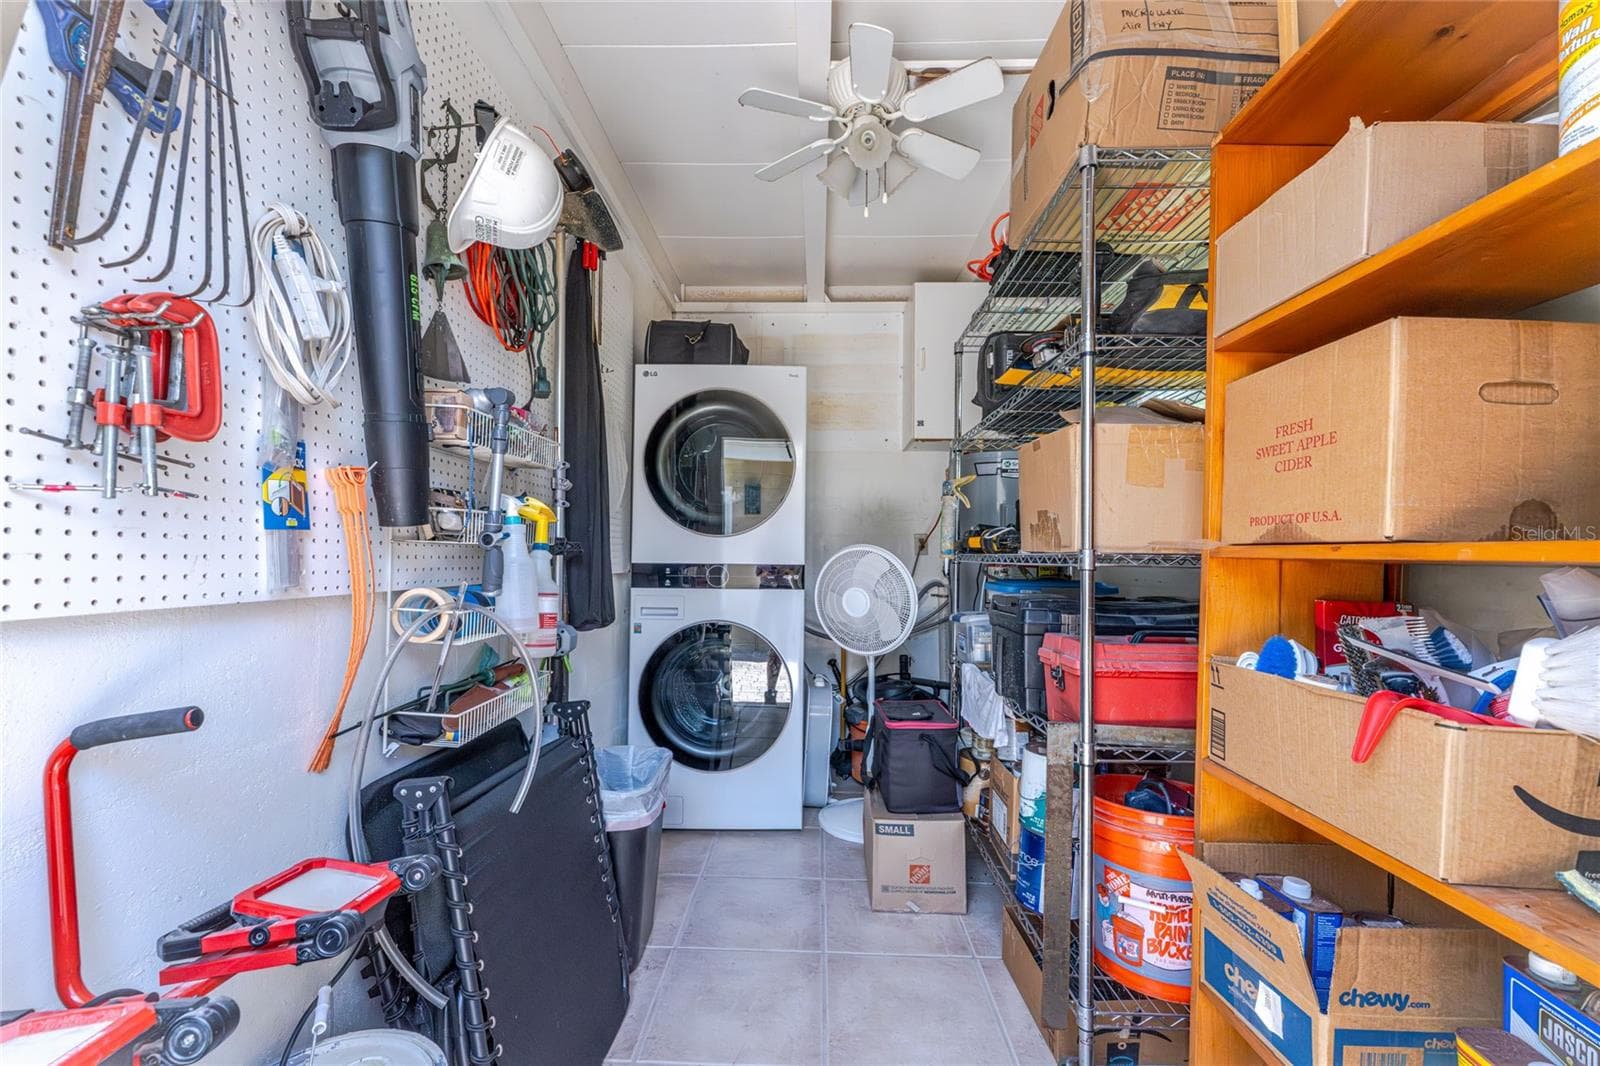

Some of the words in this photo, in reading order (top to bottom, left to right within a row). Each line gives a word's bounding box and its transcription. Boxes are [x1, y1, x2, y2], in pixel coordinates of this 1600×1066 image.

[1562, 15, 1593, 47] Wall
[1559, 28, 1600, 63] exture
[1171, 70, 1195, 78] PLACE
[1275, 418, 1314, 439] FRESH
[1255, 440, 1295, 460] SWEET
[1296, 430, 1338, 452] APPLE
[1274, 455, 1313, 473] CIDER
[1249, 513, 1295, 527] PRODUCT
[1295, 512, 1312, 523] OF
[1312, 509, 1342, 523] U.S.A.
[879, 825, 911, 835] SMALL
[1147, 938, 1192, 961] BUCKE
[1224, 963, 1258, 999] che
[1543, 1018, 1598, 1066] JASCO
